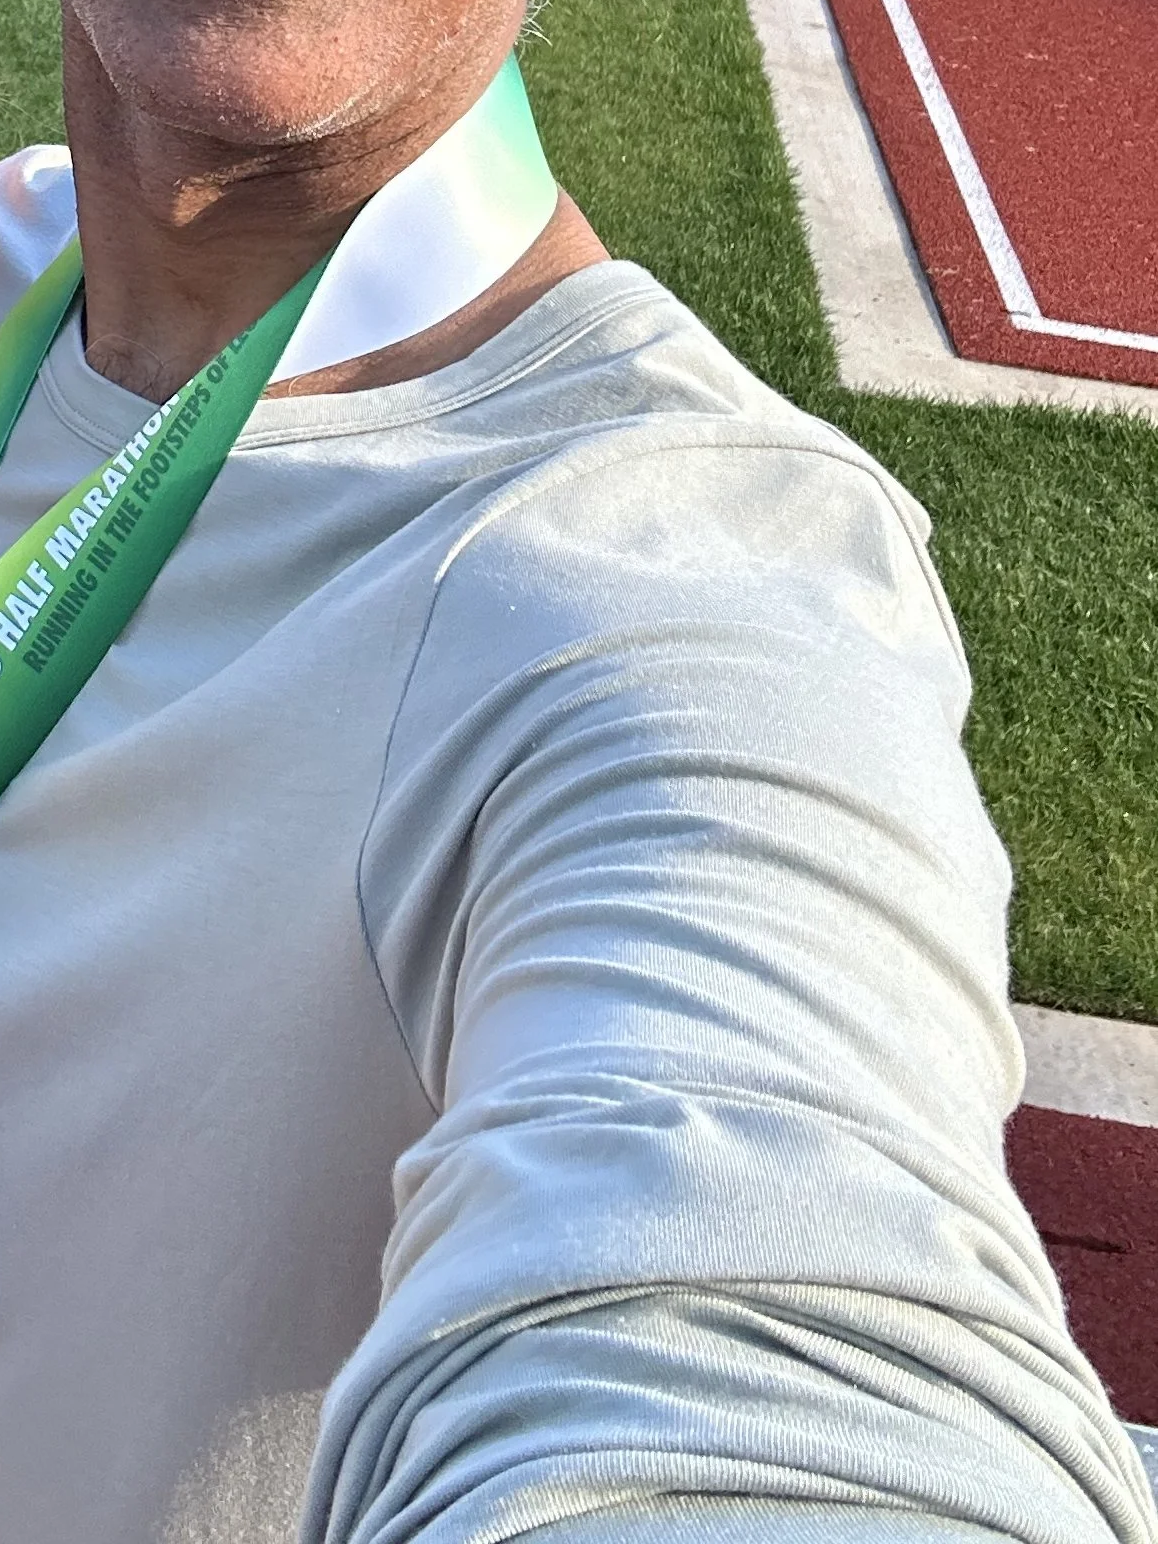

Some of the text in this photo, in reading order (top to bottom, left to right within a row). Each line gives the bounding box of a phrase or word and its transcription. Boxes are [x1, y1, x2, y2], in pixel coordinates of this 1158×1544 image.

[22, 568, 98, 674] RUNNING
[87, 538, 117, 573] IN
[105, 496, 143, 543] THE
[132, 383, 211, 503] FOOTSTEPS
